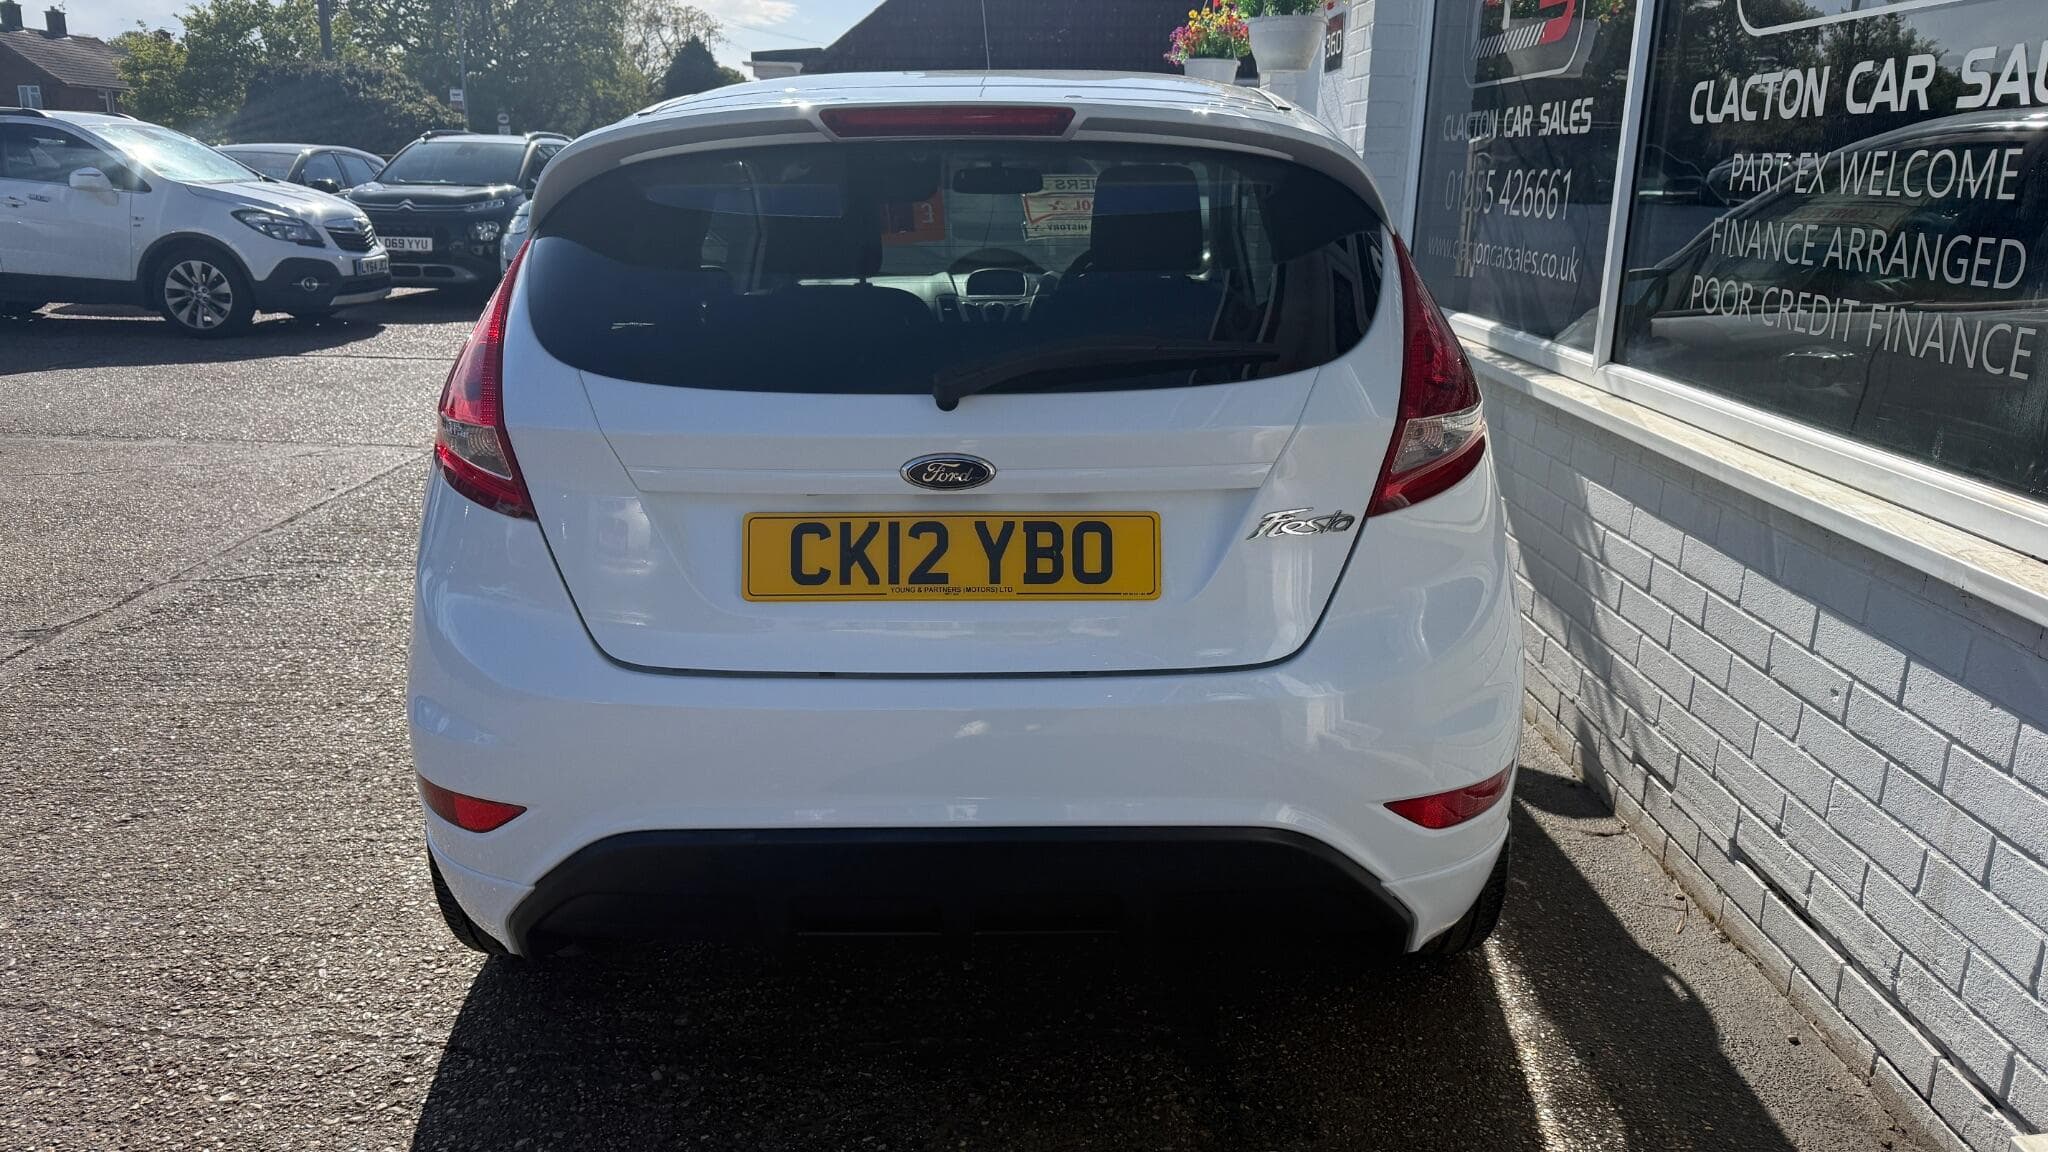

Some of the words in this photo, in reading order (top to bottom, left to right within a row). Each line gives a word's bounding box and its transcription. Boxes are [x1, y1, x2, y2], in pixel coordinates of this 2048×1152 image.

[1326, 30, 1342, 58] 360
[1690, 65, 1831, 125] CLACTON
[1846, 54, 1936, 115] CAR
[1443, 108, 1499, 142] CLACTON
[1503, 105, 1534, 138] CAR
[1538, 97, 1594, 136] SALES
[1498, 168, 1573, 221] 426661
[1729, 152, 1790, 193] PART
[1795, 151, 1831, 195] EX
[1840, 148, 2024, 201] WELCOME
[407, 239, 428, 250] YYU
[1710, 217, 1819, 267] FINANCE
[1822, 226, 2027, 290] ARRANGED
[1690, 274, 1755, 323] POOR
[1761, 286, 1861, 343] CREDIT
[1866, 303, 2038, 380] FINANCE
[922, 462, 975, 482] Ford
[1246, 506, 1356, 541] Fiesta
[791, 521, 949, 586] CK12
[974, 520, 1113, 585] YBO
